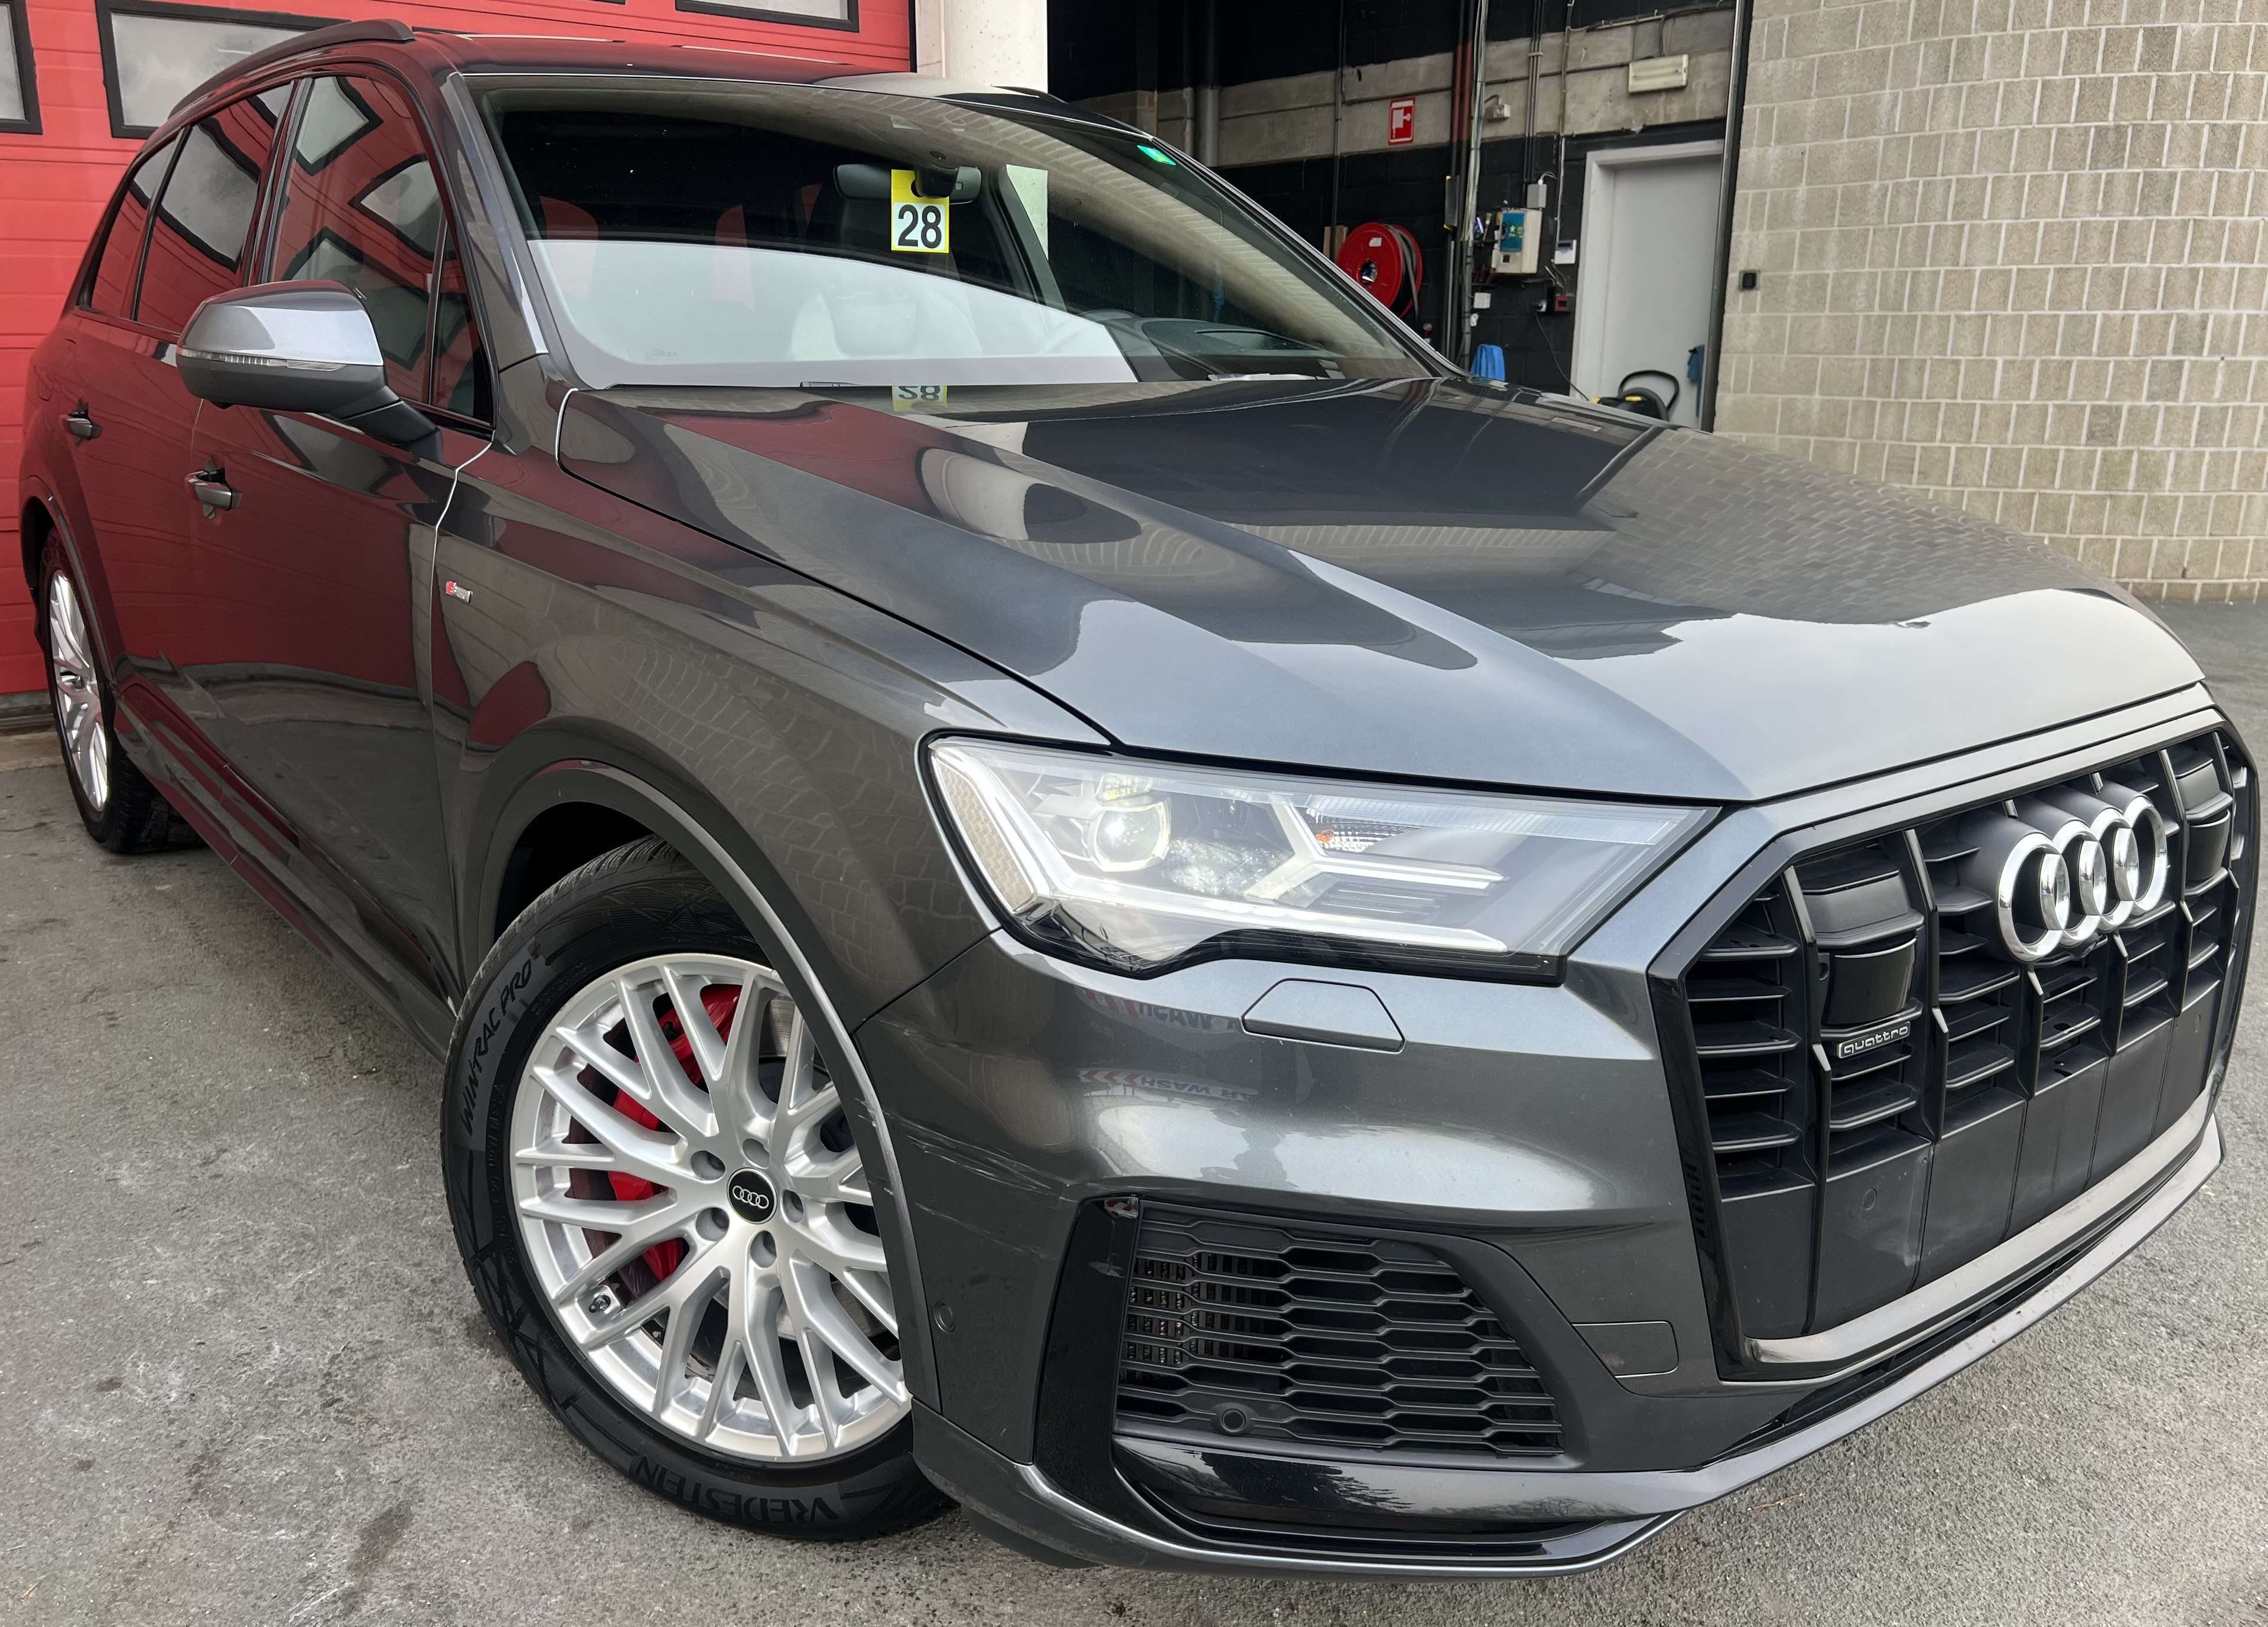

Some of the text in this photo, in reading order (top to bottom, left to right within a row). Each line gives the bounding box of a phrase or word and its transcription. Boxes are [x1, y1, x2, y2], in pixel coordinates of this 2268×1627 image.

[897, 204, 942, 249] 28
[459, 1006, 501, 1137] WINTRAC
[500, 958, 533, 1016] PRO
[1844, 1026, 1908, 1054] quattro
[635, 1454, 841, 1524] VREDESTEIN
